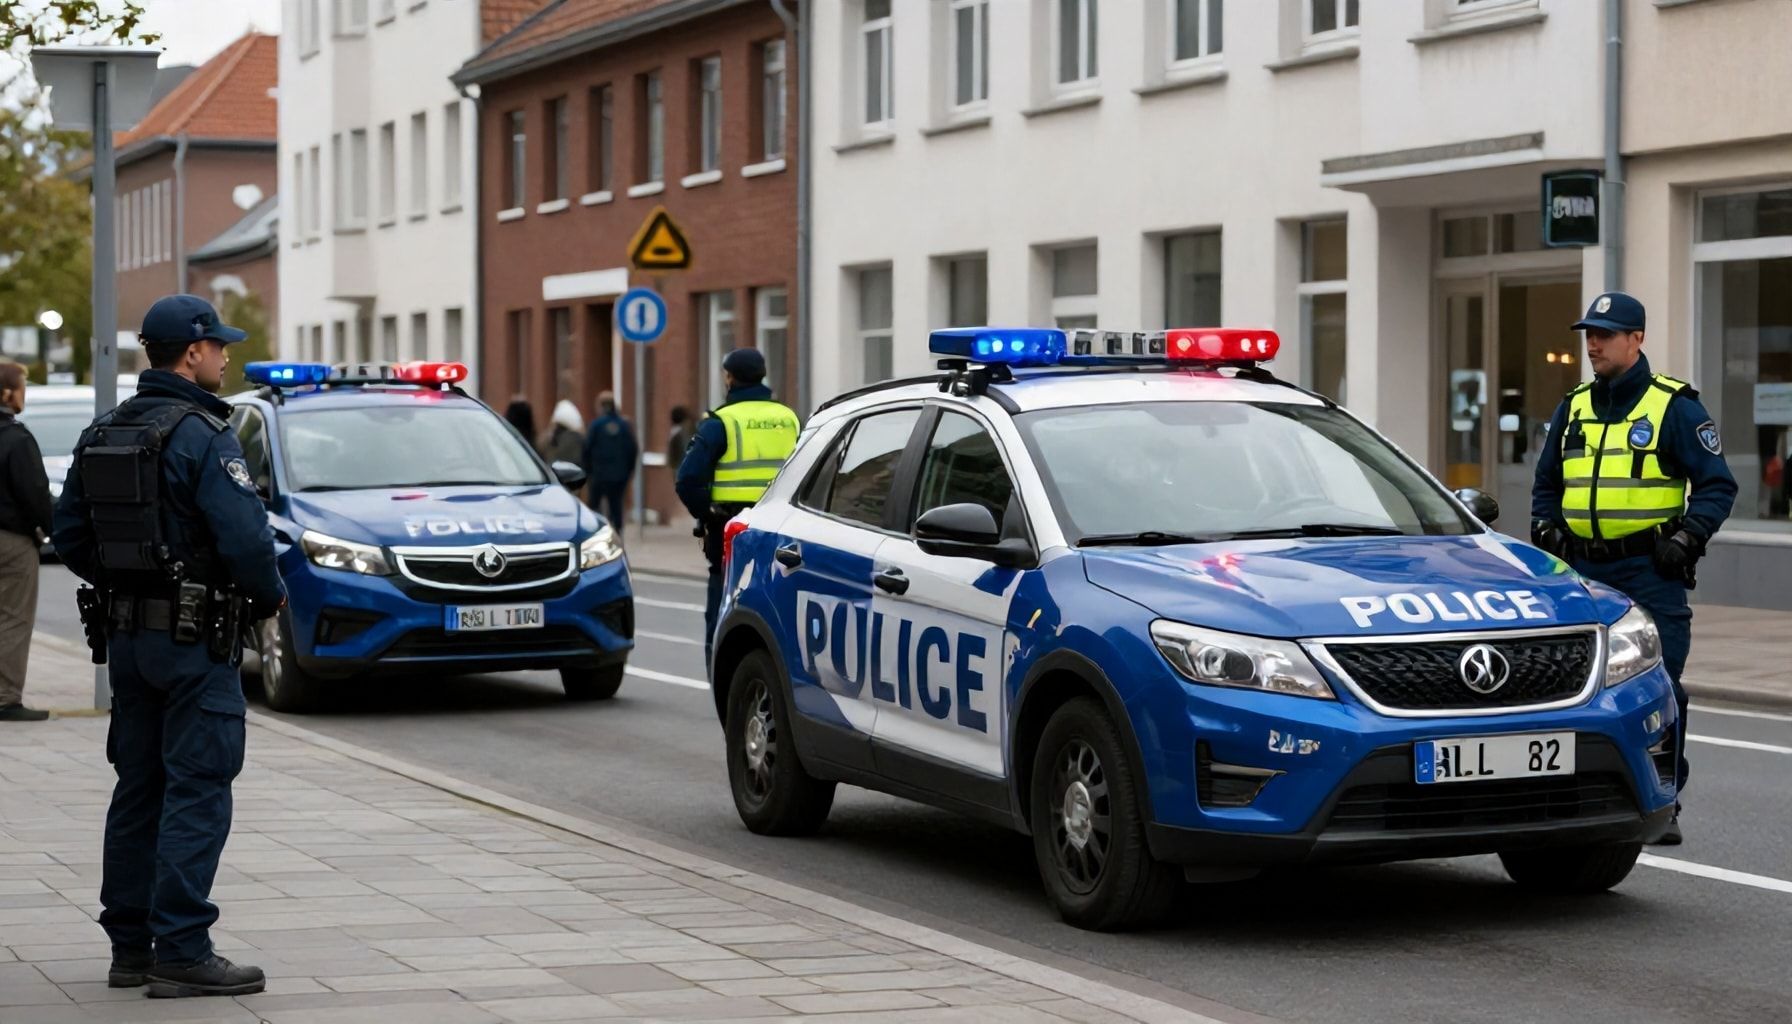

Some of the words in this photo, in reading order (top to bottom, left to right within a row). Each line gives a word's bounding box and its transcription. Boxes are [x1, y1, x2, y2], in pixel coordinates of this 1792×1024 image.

[1340, 590, 1549, 628] POLICE
[805, 599, 988, 734] POLICE
[1528, 738, 1561, 772] 82
